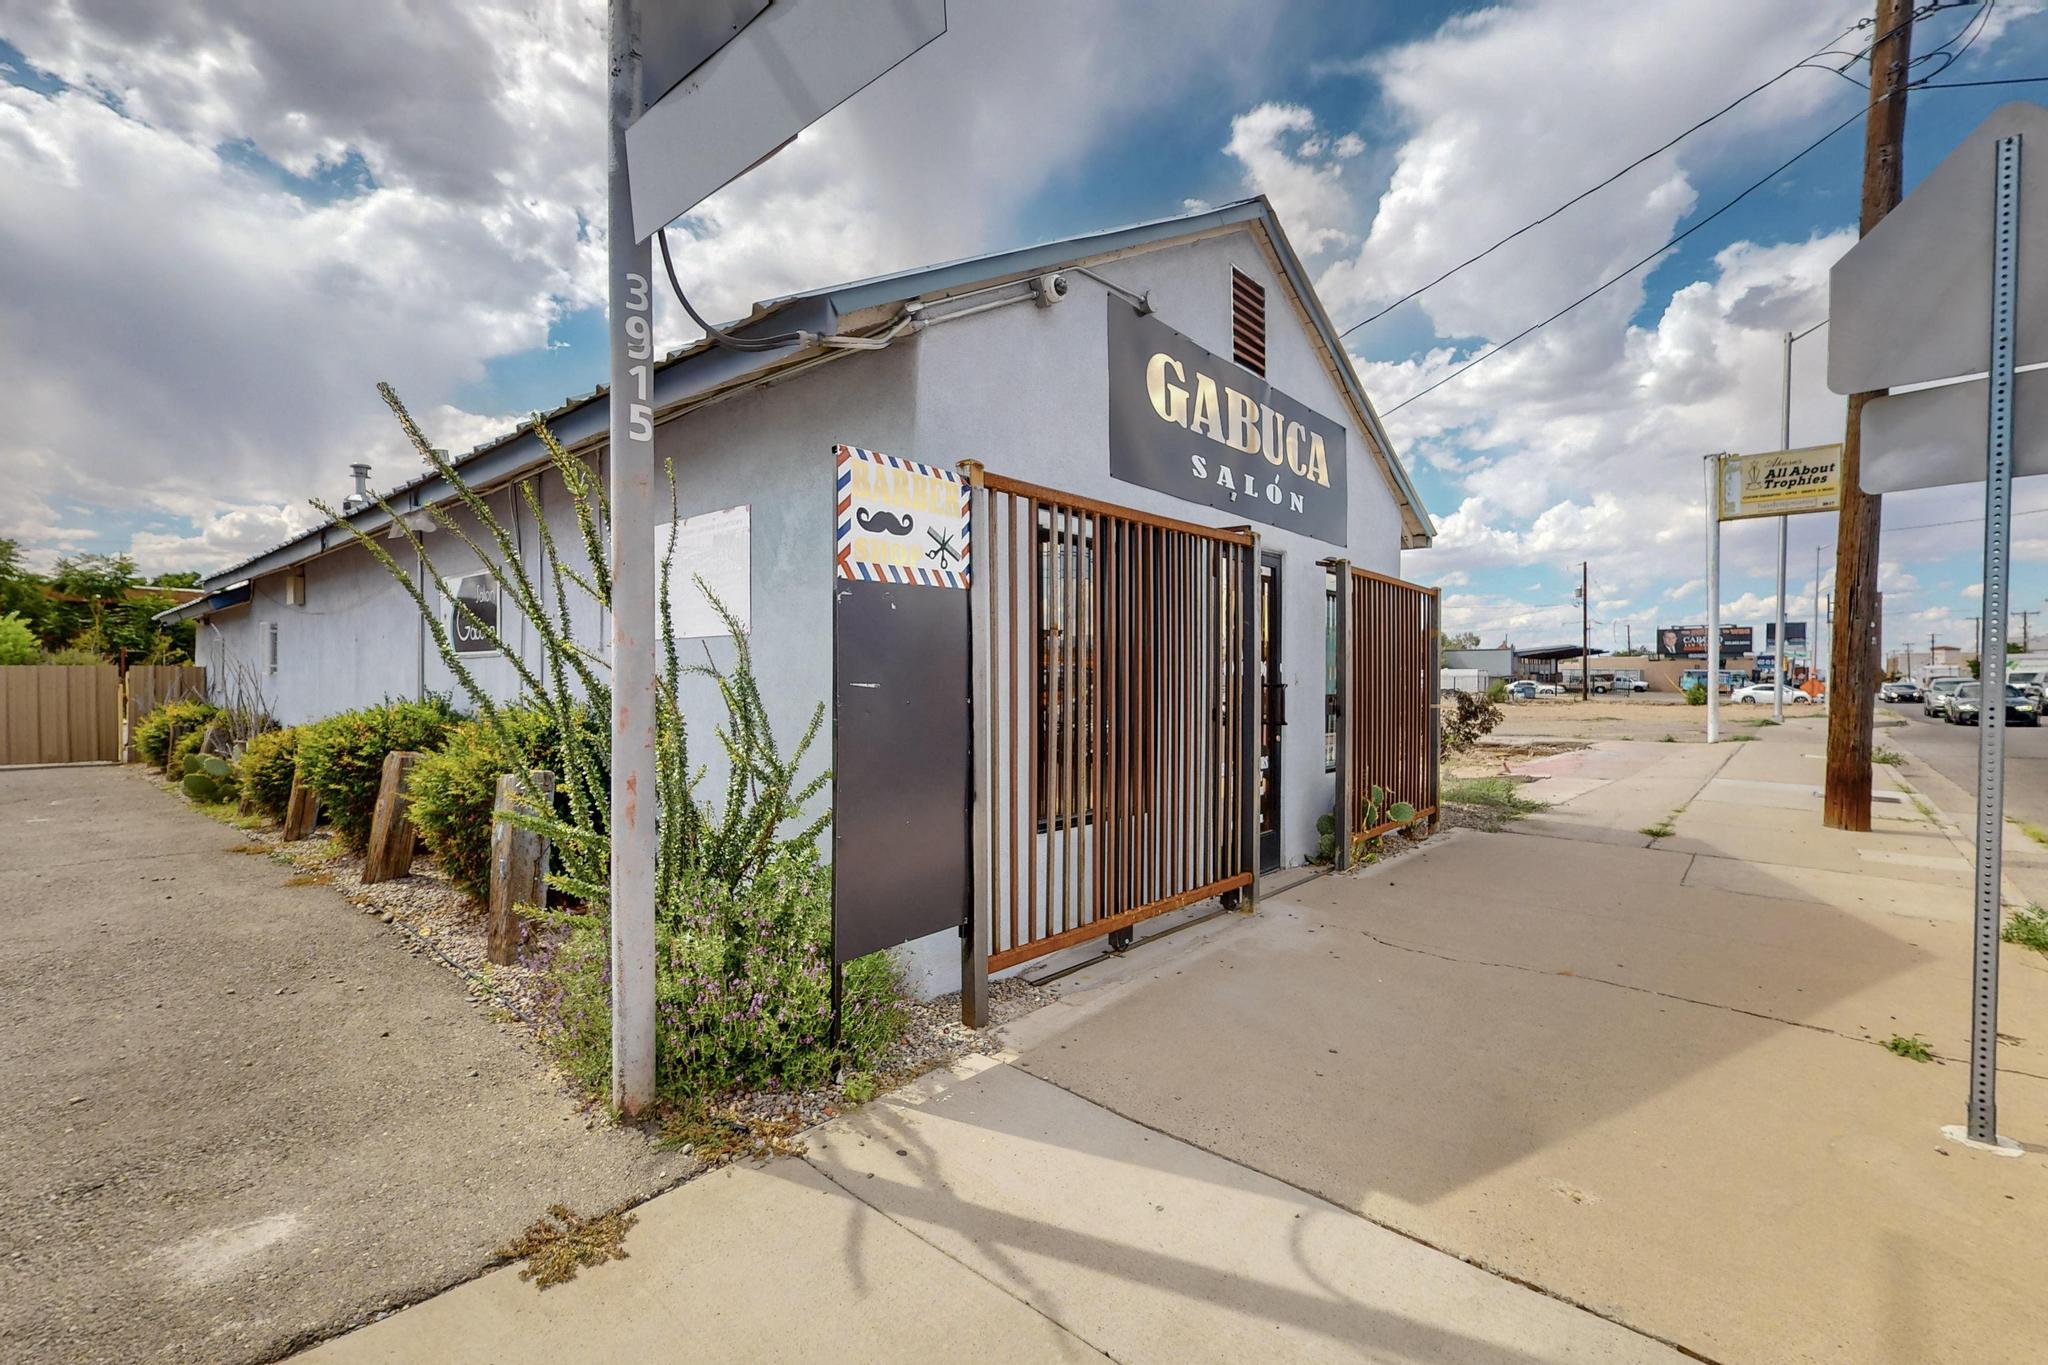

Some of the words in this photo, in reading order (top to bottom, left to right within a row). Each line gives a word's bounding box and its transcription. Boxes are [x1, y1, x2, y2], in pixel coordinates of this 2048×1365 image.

[625, 273, 654, 442] 3915
[1146, 352, 1331, 488] GABUCA
[853, 461, 960, 518] BARBER
[1191, 454, 1304, 514] SALÓN
[1764, 467, 1788, 479] All
[1789, 463, 1835, 477] About
[1764, 475, 1828, 489] Trophies
